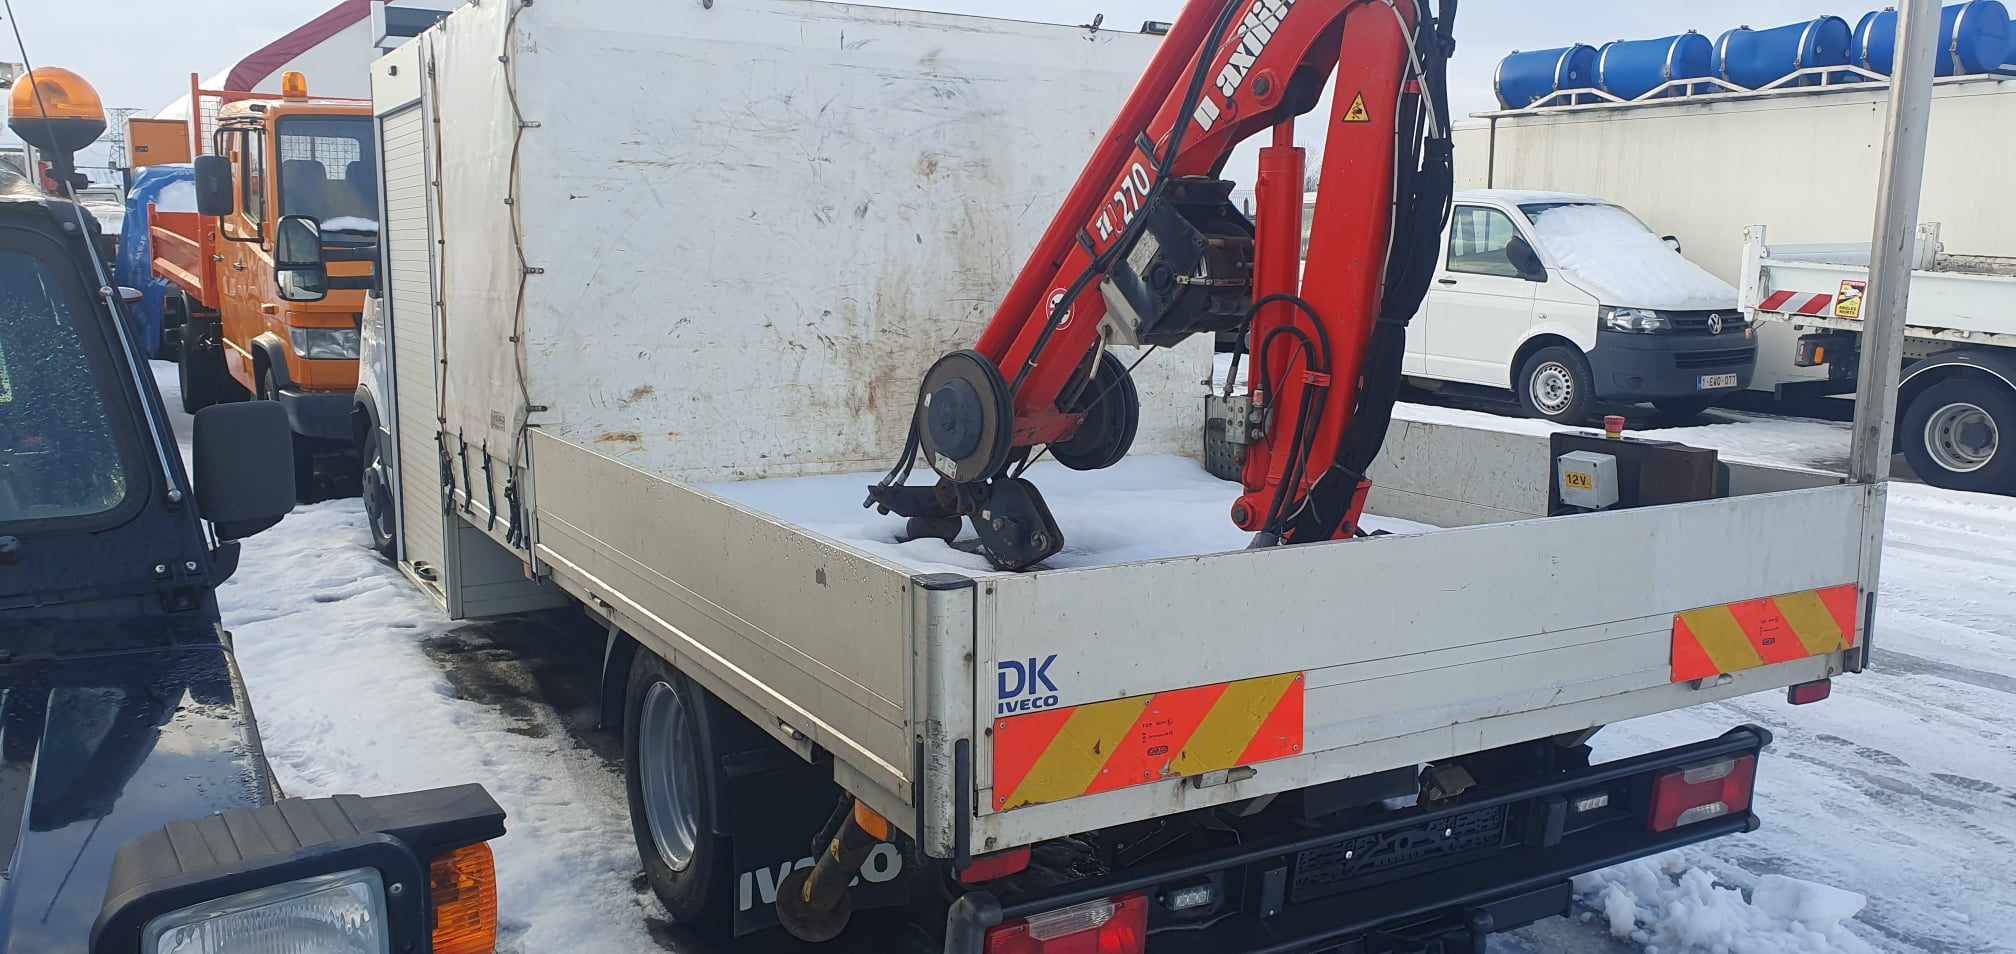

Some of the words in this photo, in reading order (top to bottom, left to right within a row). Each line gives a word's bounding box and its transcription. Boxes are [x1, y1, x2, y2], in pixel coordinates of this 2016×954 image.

[1567, 473, 1586, 485] 12V
[998, 654, 1058, 700] DK
[998, 695, 1059, 714] IVECO
[739, 842, 902, 912] IVO
